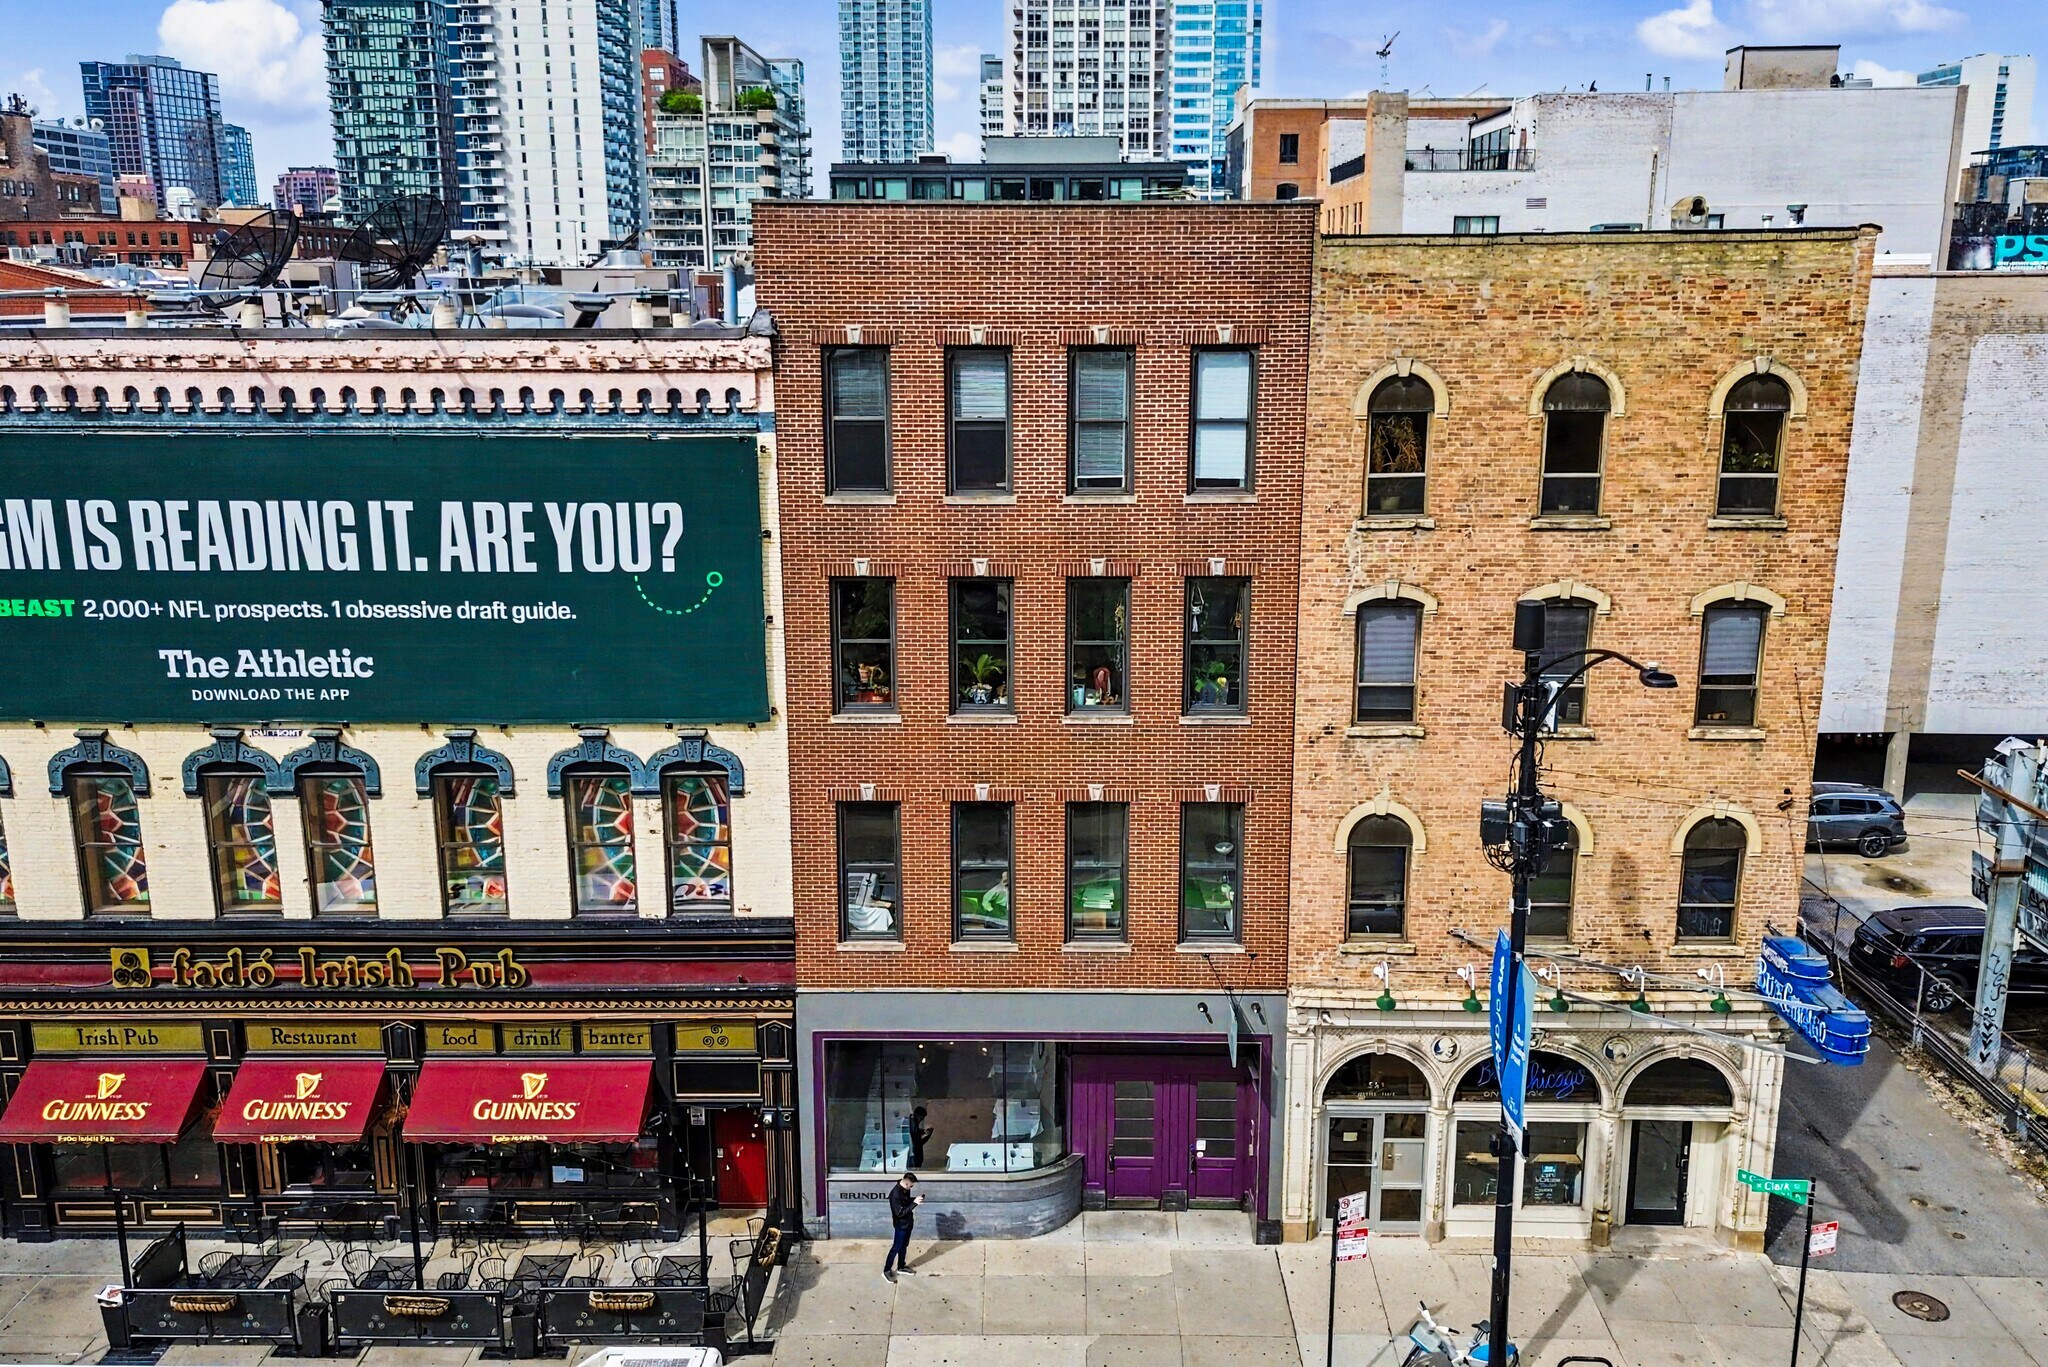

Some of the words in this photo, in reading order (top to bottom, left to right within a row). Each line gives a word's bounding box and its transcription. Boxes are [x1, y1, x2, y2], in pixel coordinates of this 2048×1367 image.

[65, 499, 122, 571] IS
[128, 499, 360, 571] READING
[367, 500, 428, 572] IT.
[440, 501, 538, 572] ARE
[543, 501, 684, 573] YOU?
[0, 599, 75, 617] BEAST
[83, 599, 163, 620] 2,000+
[168, 600, 211, 619] NFL
[214, 600, 329, 622] prospects.
[331, 601, 341, 618] 1
[345, 600, 452, 619] obsessive
[456, 601, 508, 619] draft
[511, 602, 577, 624] guide.
[158, 649, 230, 678] The
[234, 648, 375, 678] Athletic
[191, 689, 281, 701] DOWNLOAD
[284, 688, 316, 701] THE
[319, 689, 350, 701] APP
[171, 947, 275, 987] fadó
[298, 947, 415, 988] Irish
[435, 947, 528, 988] Pub
[76, 1028, 119, 1045] Irish
[123, 1028, 159, 1046] Pub
[271, 1028, 357, 1046] Restaurant
[442, 1028, 478, 1045] food
[514, 1028, 561, 1046] drink
[589, 1028, 644, 1045] banter
[1527, 1060, 1586, 1099] hicago
[42, 1099, 149, 1121] GUINNESS
[242, 1099, 349, 1121] GUINNESS
[472, 1099, 578, 1121] GUINNESS
[840, 1192, 890, 1200] BRINDIL
